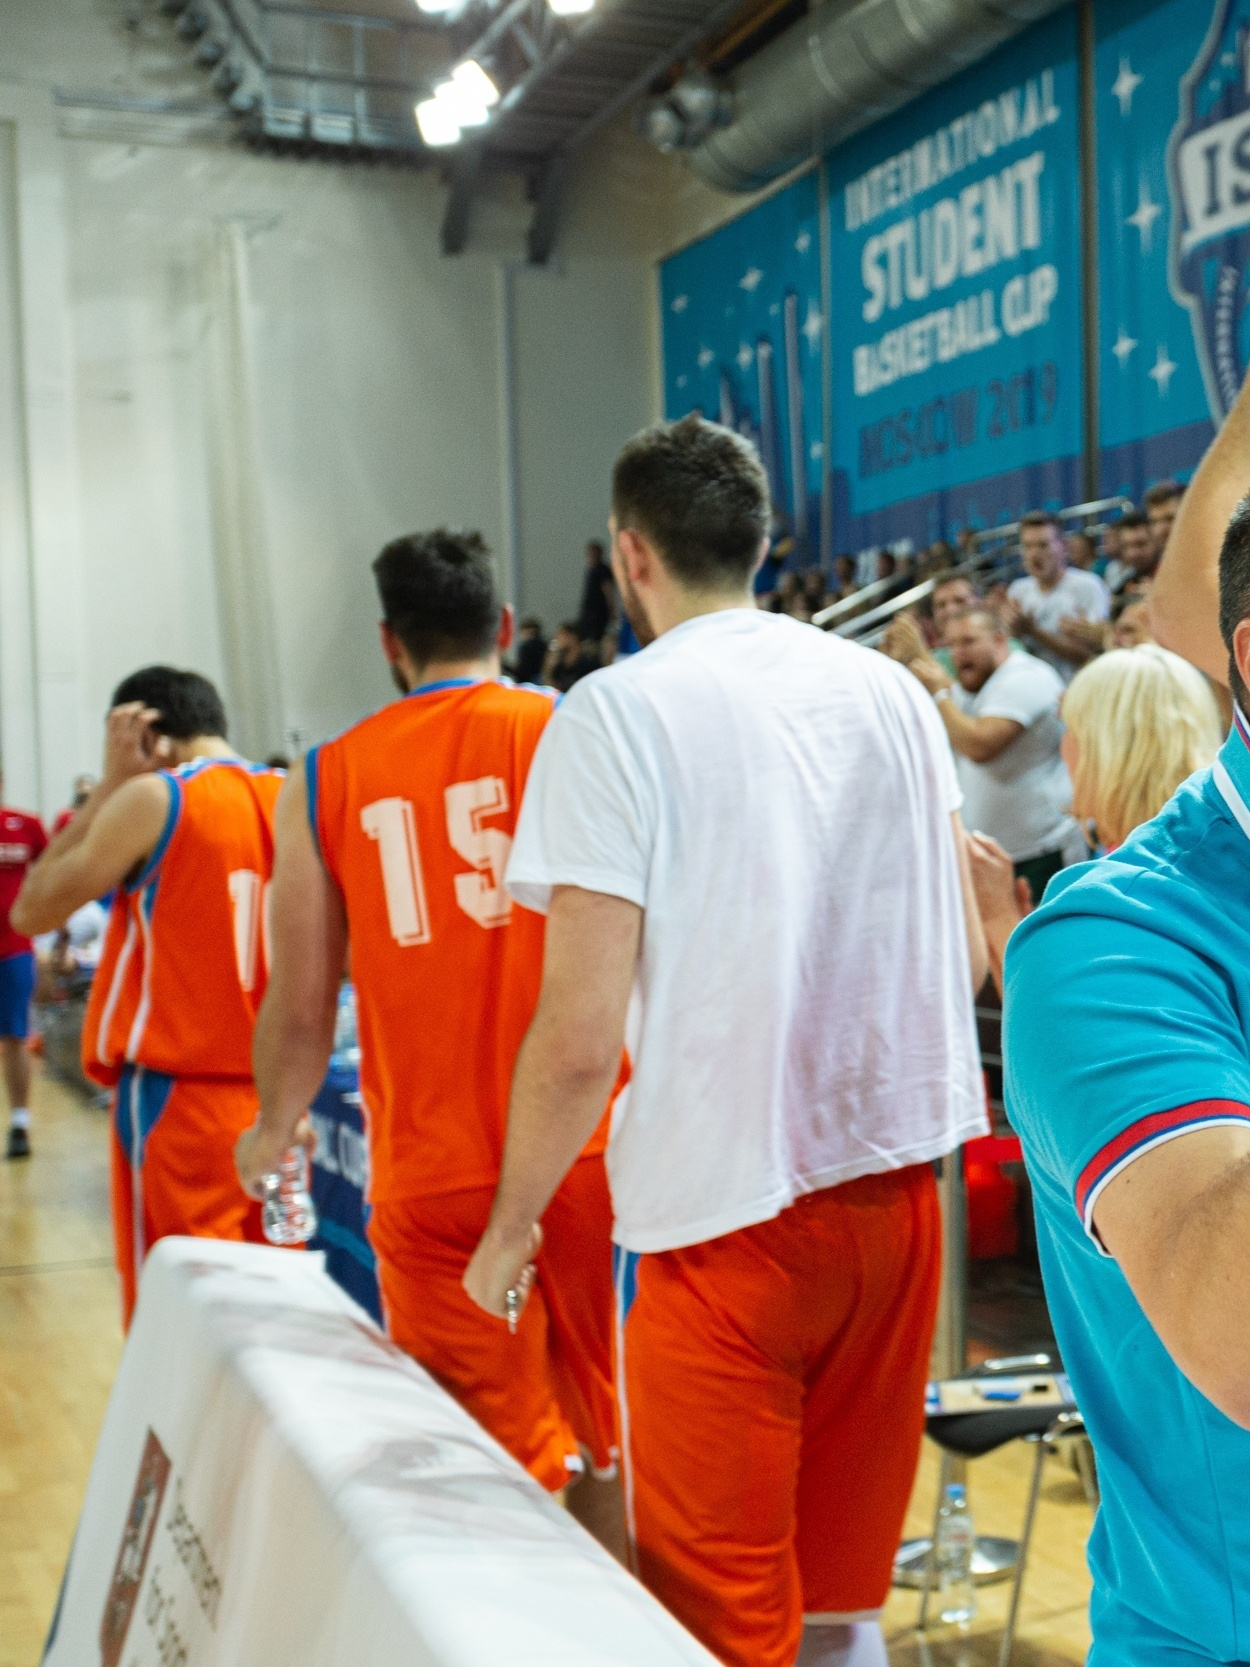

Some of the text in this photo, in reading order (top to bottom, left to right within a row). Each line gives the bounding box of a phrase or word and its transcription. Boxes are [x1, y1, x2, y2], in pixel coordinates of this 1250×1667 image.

[845, 68, 1060, 231] INTERNATIONAL
[862, 151, 1045, 323] STUDENT
[853, 263, 1059, 396] BASKETBALL CUP
[360, 776, 515, 948] 15
